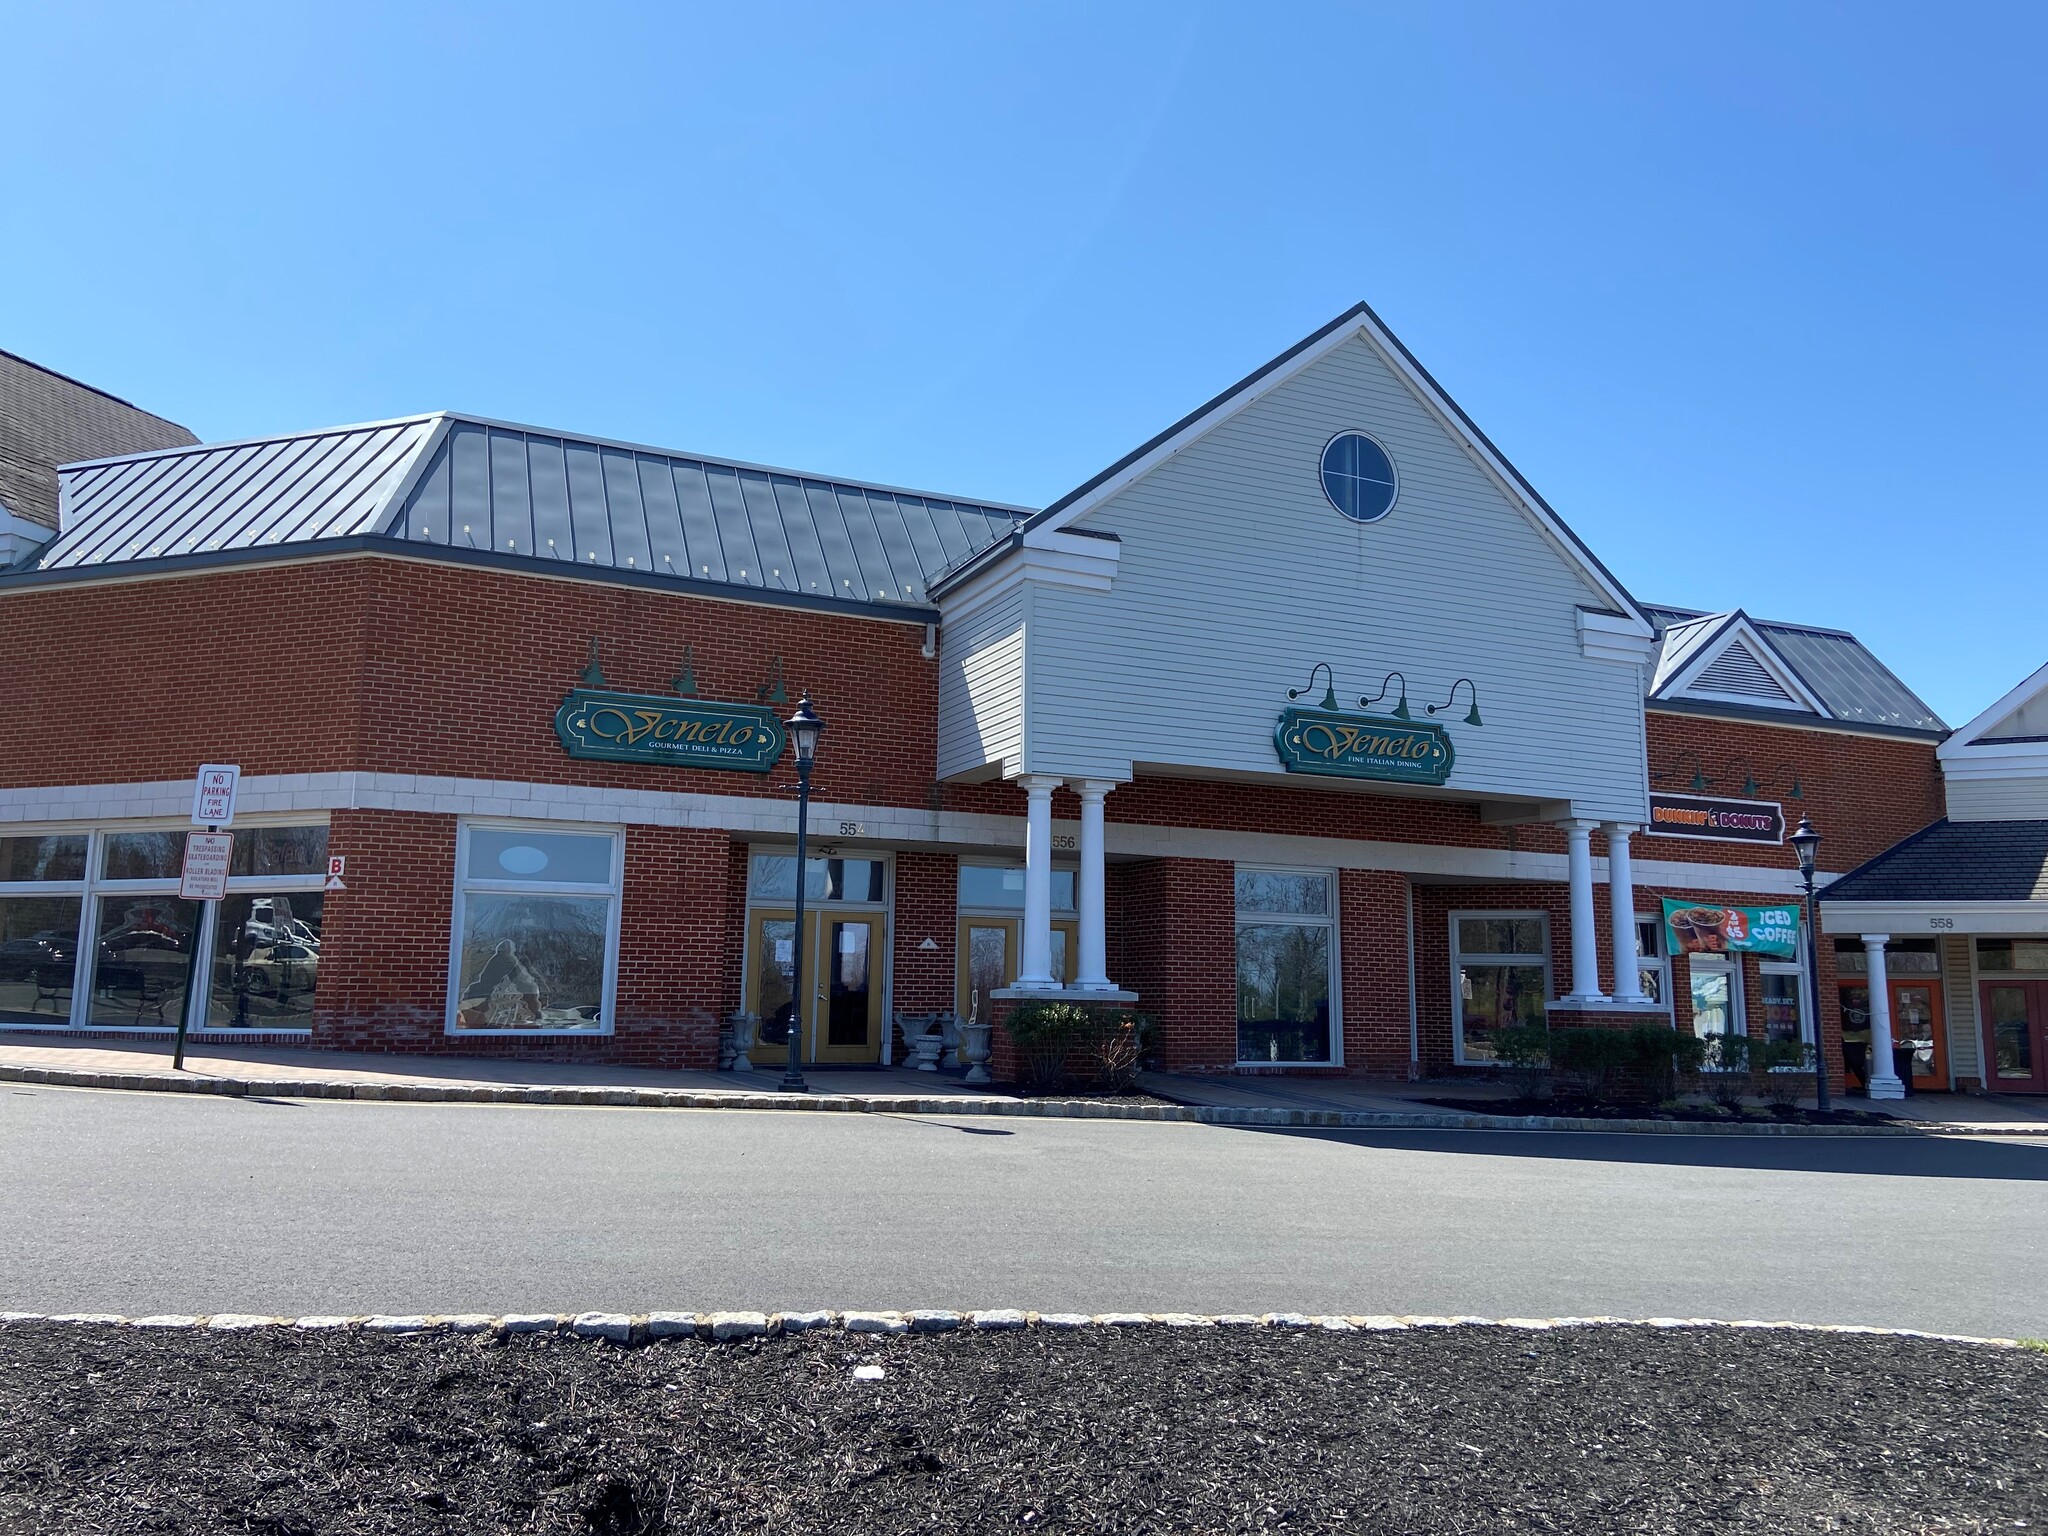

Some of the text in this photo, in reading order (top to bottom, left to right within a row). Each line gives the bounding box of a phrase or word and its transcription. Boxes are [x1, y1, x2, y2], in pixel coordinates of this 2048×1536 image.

[590, 708, 754, 745] Veneto
[648, 741, 689, 751] GOURMET
[691, 744, 709, 752] DELI
[719, 747, 743, 755] PIZZA
[1303, 725, 1430, 760] Veneto
[1348, 756, 1422, 768] FINE ITALIAN DINING
[212, 775, 224, 785] NO
[203, 786, 230, 797] PARKING
[207, 798, 223, 807] FIRE
[204, 808, 223, 816] LANE
[1653, 806, 1772, 831] DUNKIN' DONUTS
[839, 822, 865, 836] 554
[205, 837, 216, 845] NO
[1052, 835, 1075, 849] 556
[192, 845, 226, 853] TRESPASSING
[188, 853, 228, 862] SKATEBOARDING
[186, 867, 226, 876] ROLLER BLADING
[331, 858, 342, 874] B
[1727, 909, 1739, 921] 2
[1759, 910, 1791, 926] ICED
[1930, 917, 1954, 929] 558
[1726, 925, 1744, 938] $5
[1751, 927, 1798, 945] COFFEE
